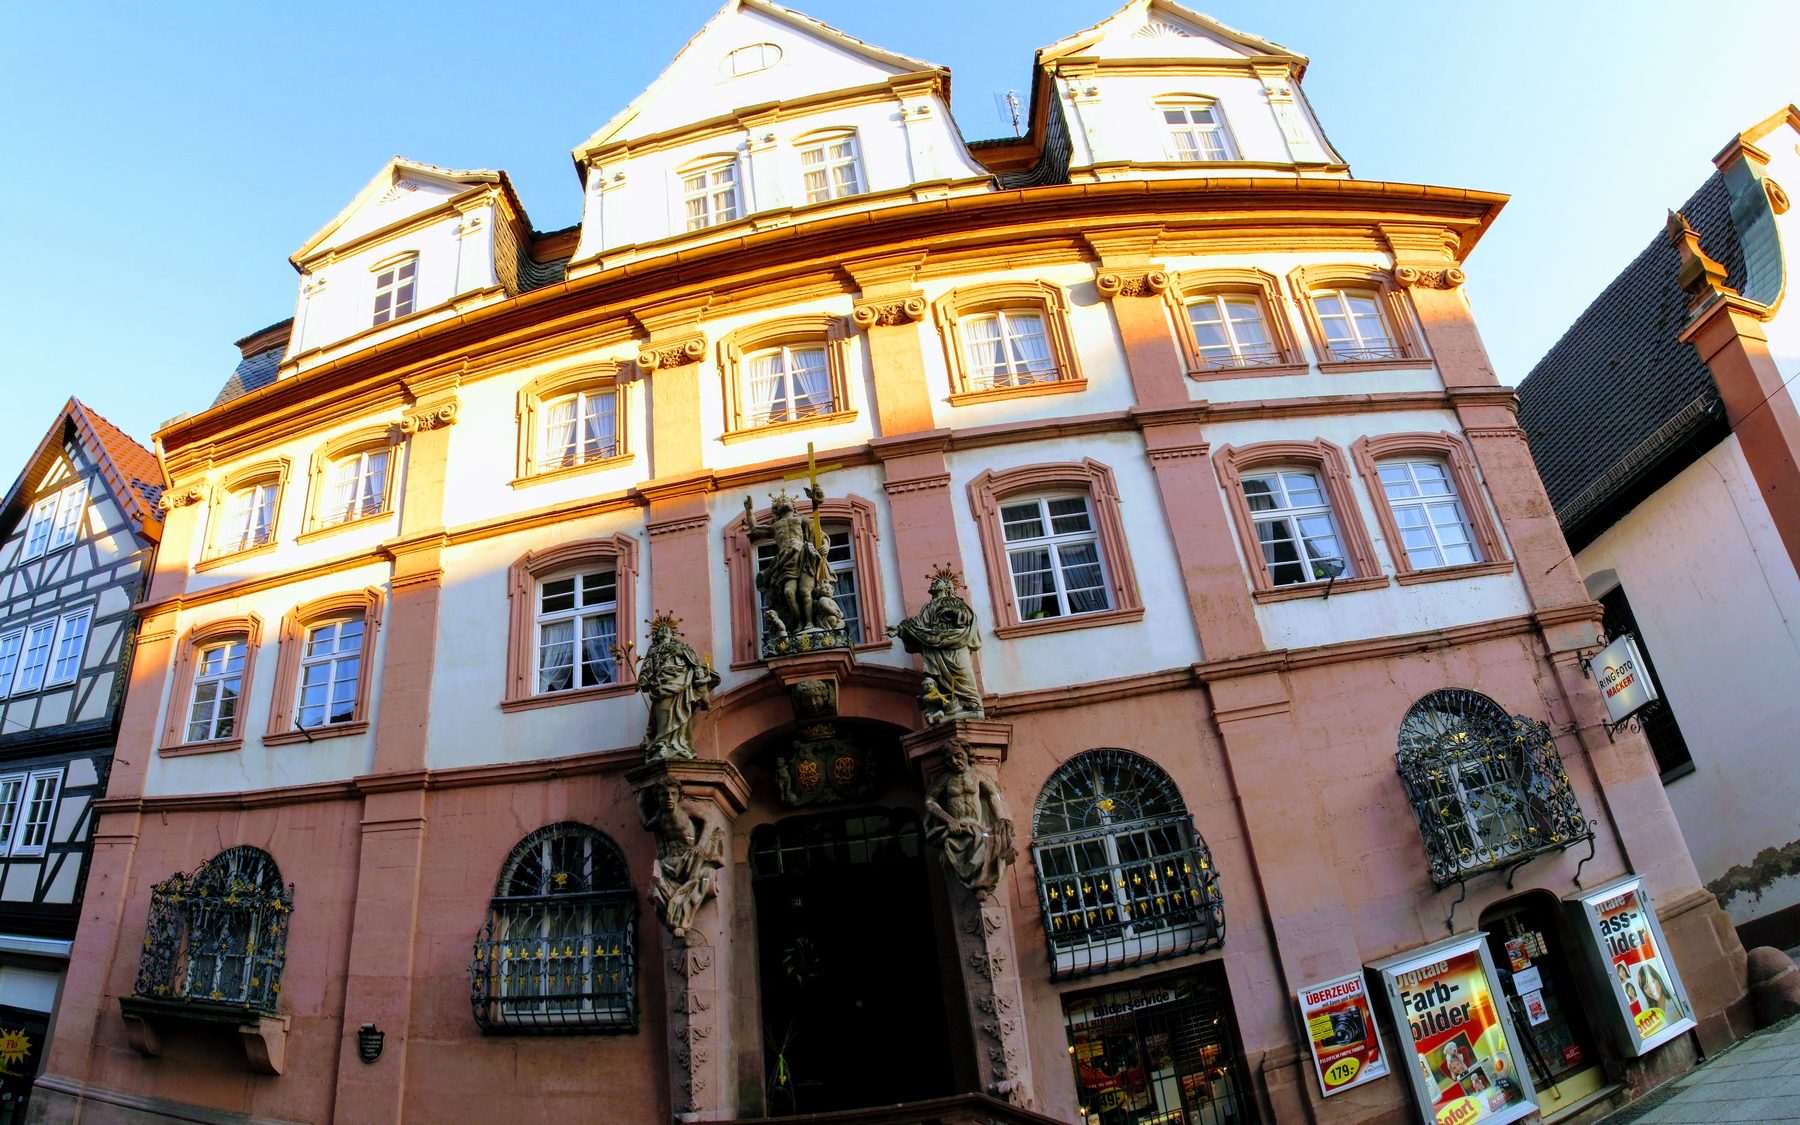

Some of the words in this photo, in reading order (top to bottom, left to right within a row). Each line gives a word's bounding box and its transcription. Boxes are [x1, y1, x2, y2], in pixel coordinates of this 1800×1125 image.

[1606, 673, 1636, 698] MACKERT
[1599, 912, 1637, 936] ass-
[1605, 928, 1646, 957] ilder
[1093, 991, 1170, 1018] Bilderservice
[1306, 980, 1361, 1006] ÜBERZEUGT
[1400, 980, 1460, 1016] Farb-
[1407, 1002, 1470, 1041] bilder
